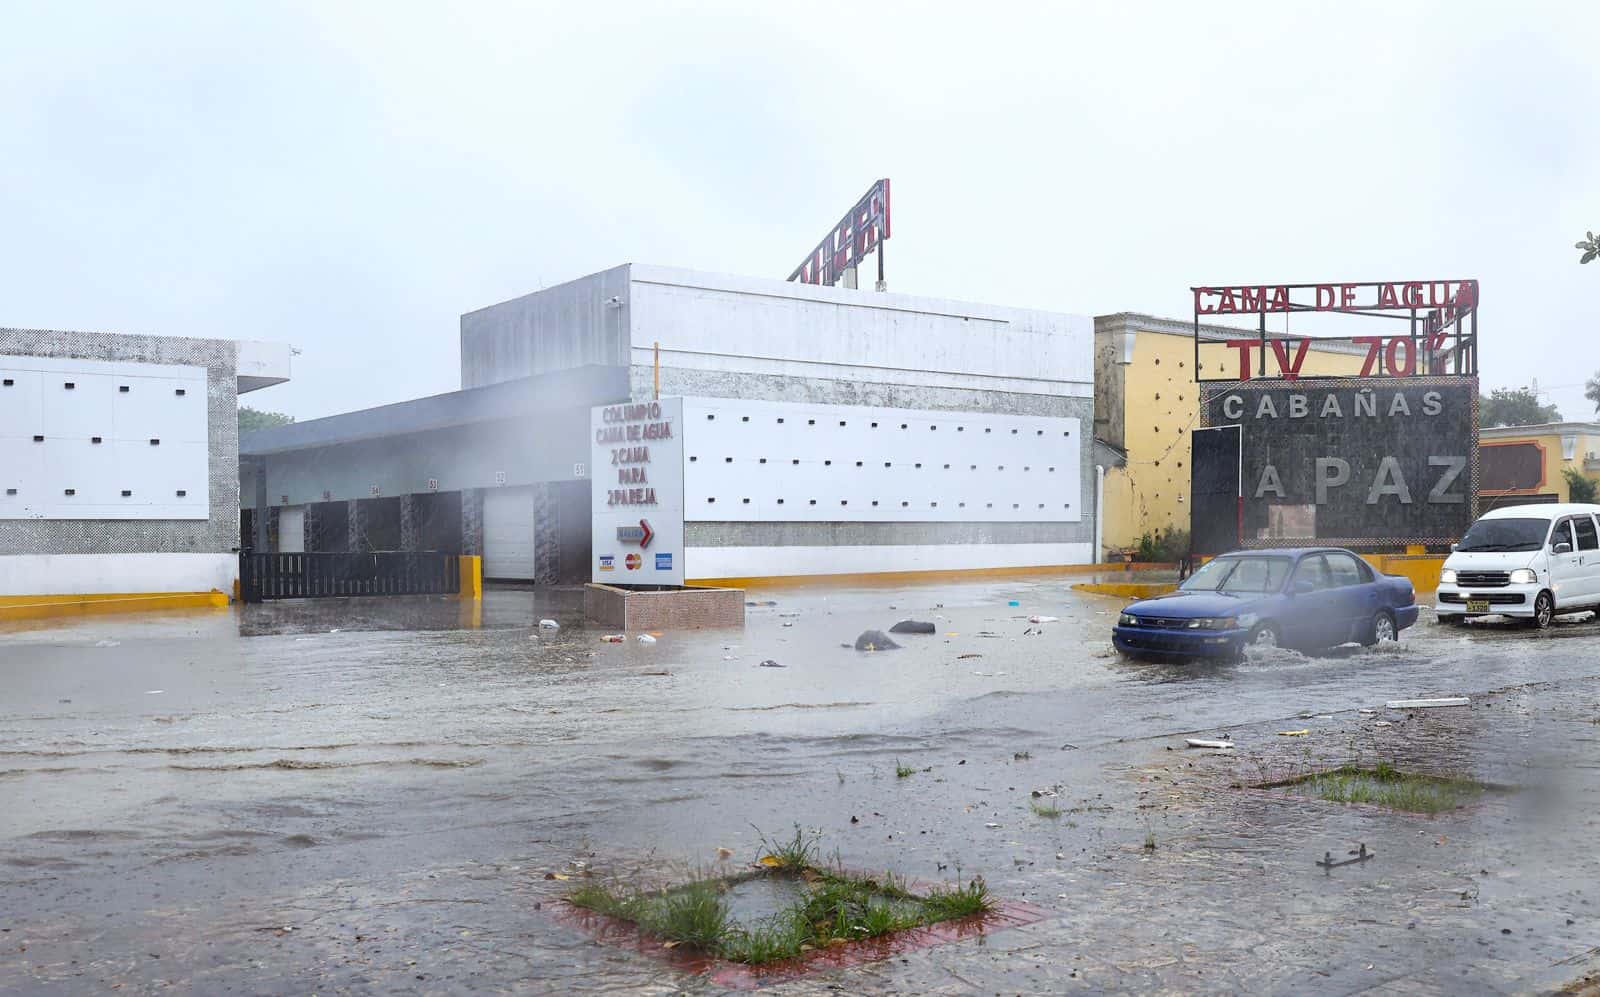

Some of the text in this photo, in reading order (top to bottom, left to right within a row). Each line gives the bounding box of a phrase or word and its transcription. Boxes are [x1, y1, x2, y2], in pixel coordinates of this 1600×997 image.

[1194, 286, 1290, 314] CAMA
[1316, 283, 1359, 311] DE
[1226, 338, 1311, 381] TV
[1223, 388, 1442, 419] CABAÑAS
[596, 427, 625, 445] CAMA
[626, 425, 641, 442] DE
[1315, 456, 1467, 505] PAZ
